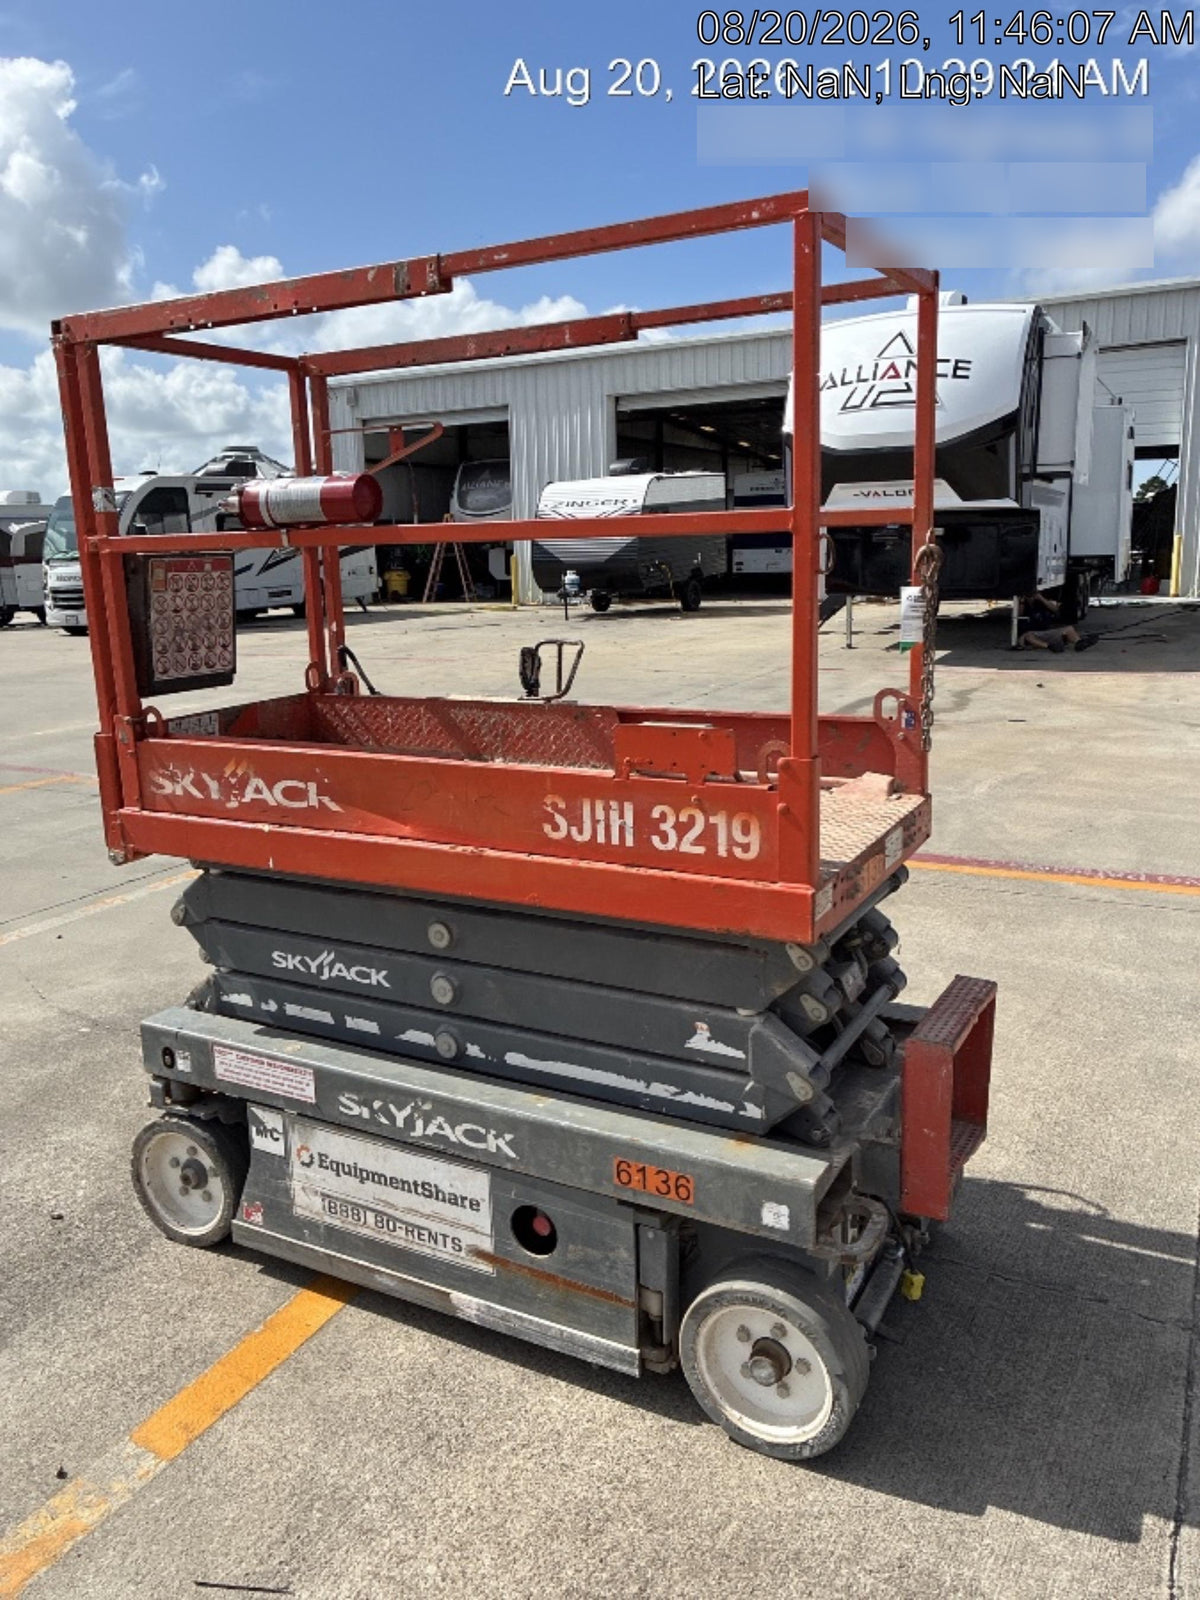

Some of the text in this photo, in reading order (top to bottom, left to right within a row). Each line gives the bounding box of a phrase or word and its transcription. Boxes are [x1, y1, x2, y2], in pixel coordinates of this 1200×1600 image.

[651, 804, 760, 861] 3219
[271, 950, 392, 988] SKYJACK
[338, 1092, 520, 1160] SKYJACK
[317, 1151, 482, 1212] EquipmentShare
[616, 1160, 691, 1201] 6136
[374, 1214, 463, 1252] 80-RENTS
